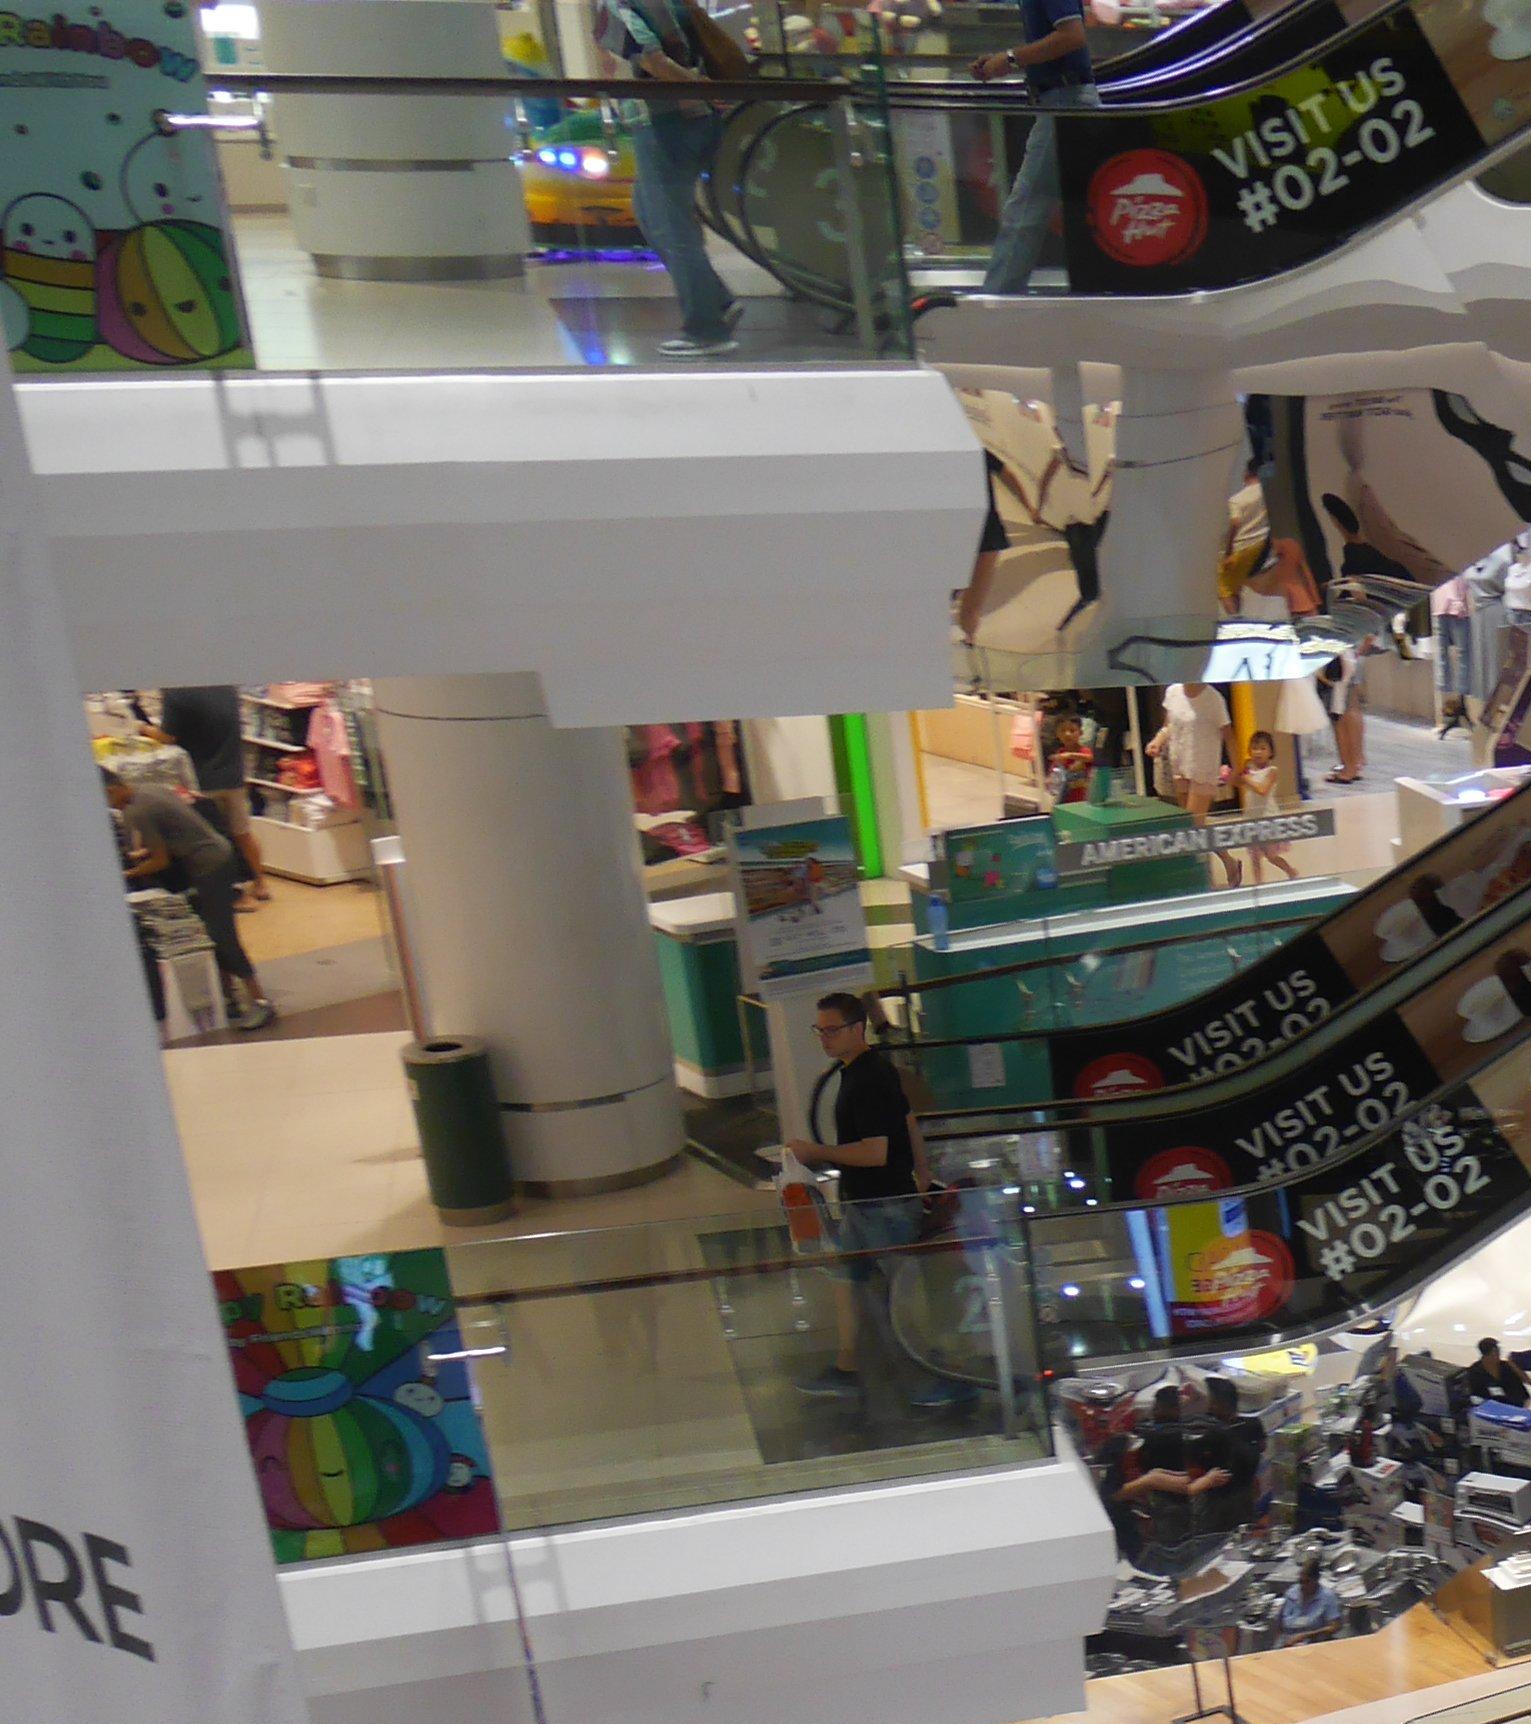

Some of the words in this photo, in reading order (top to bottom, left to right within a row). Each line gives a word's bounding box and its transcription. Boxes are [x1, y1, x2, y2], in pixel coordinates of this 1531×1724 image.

[1211, 92, 1332, 179] VISIT
[1337, 57, 1406, 113] US
[1237, 99, 1437, 233] #02-02
[1109, 195, 1181, 226] Pizza
[1121, 220, 1177, 245] Hut
[1081, 828, 1208, 866] AMERICAN
[1212, 814, 1319, 847] EXPRESS
[1166, 1000, 1261, 1068] VISIT
[1264, 969, 1318, 1013] US
[1234, 1084, 1334, 1159] VISIT
[1337, 1050, 1395, 1097] US
[1295, 1162, 1401, 1242] VISIT
[1404, 1125, 1467, 1173] US
[1319, 1155, 1491, 1282] #02-02
